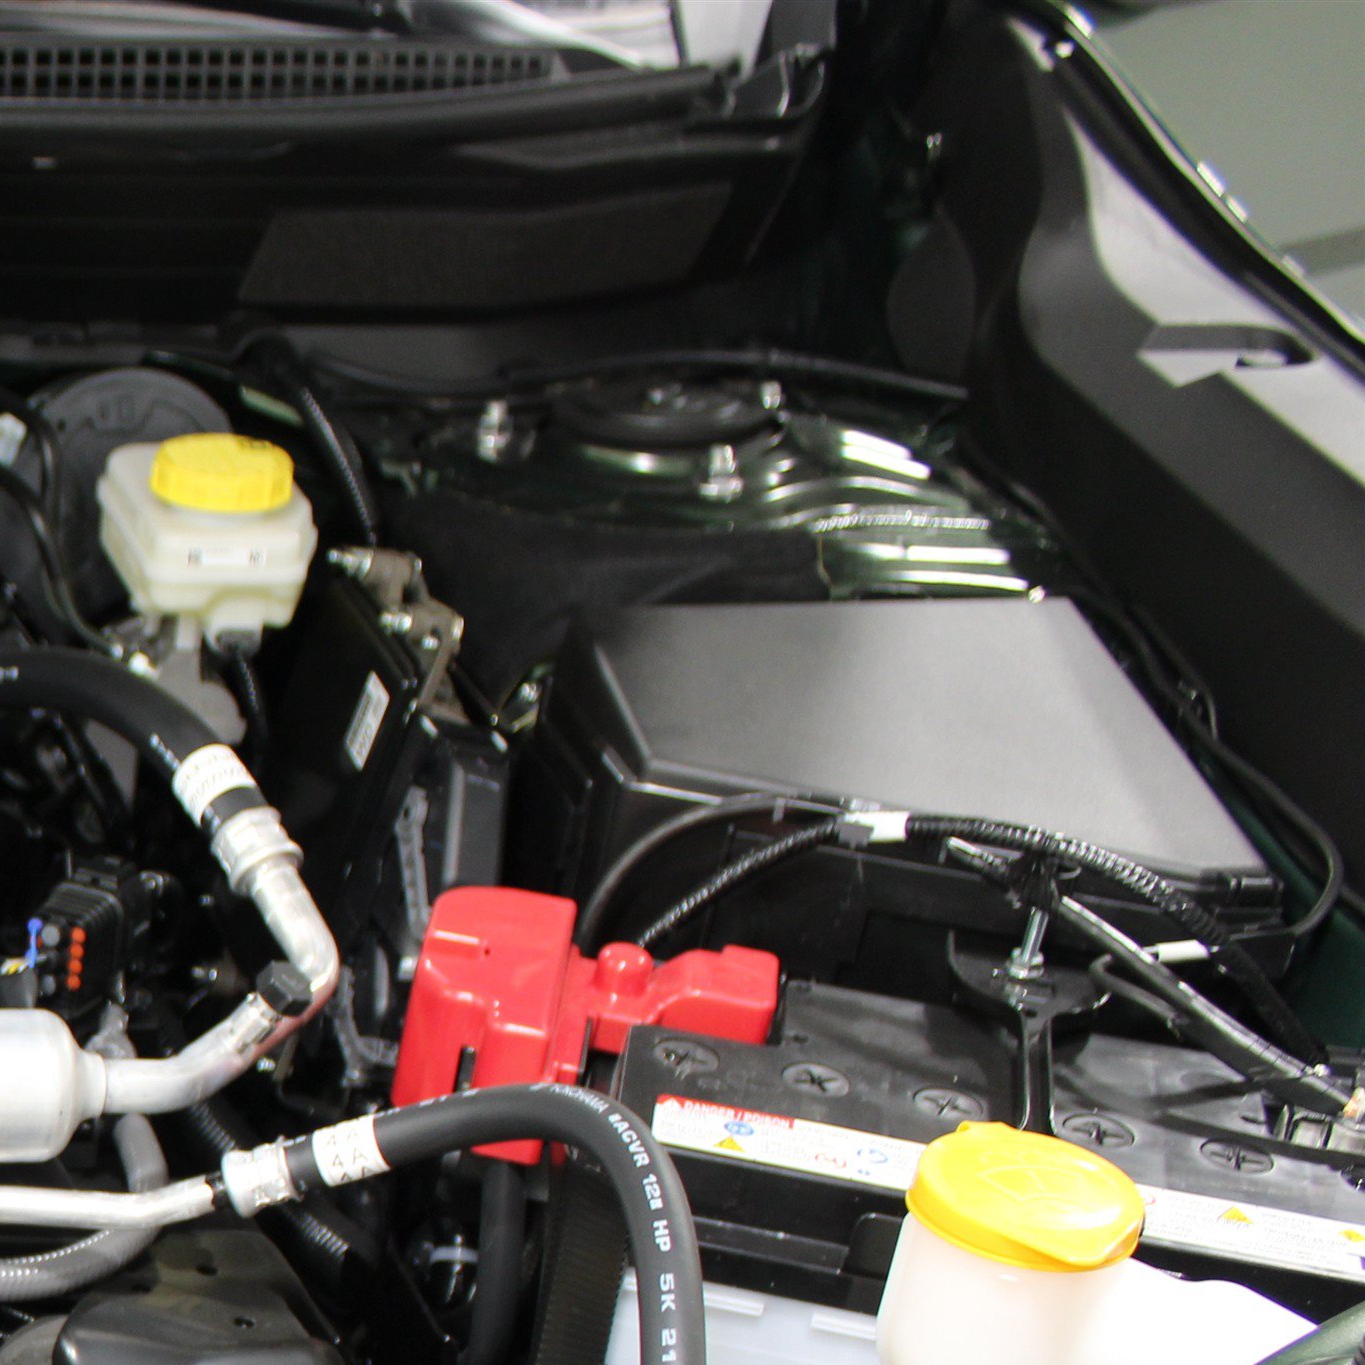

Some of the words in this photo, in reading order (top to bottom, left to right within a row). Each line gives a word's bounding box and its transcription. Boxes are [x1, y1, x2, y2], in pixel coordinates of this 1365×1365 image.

[652, 1219, 672, 1253] HP
[659, 1272, 676, 1313] 5K
[660, 1327, 677, 1363] 21
